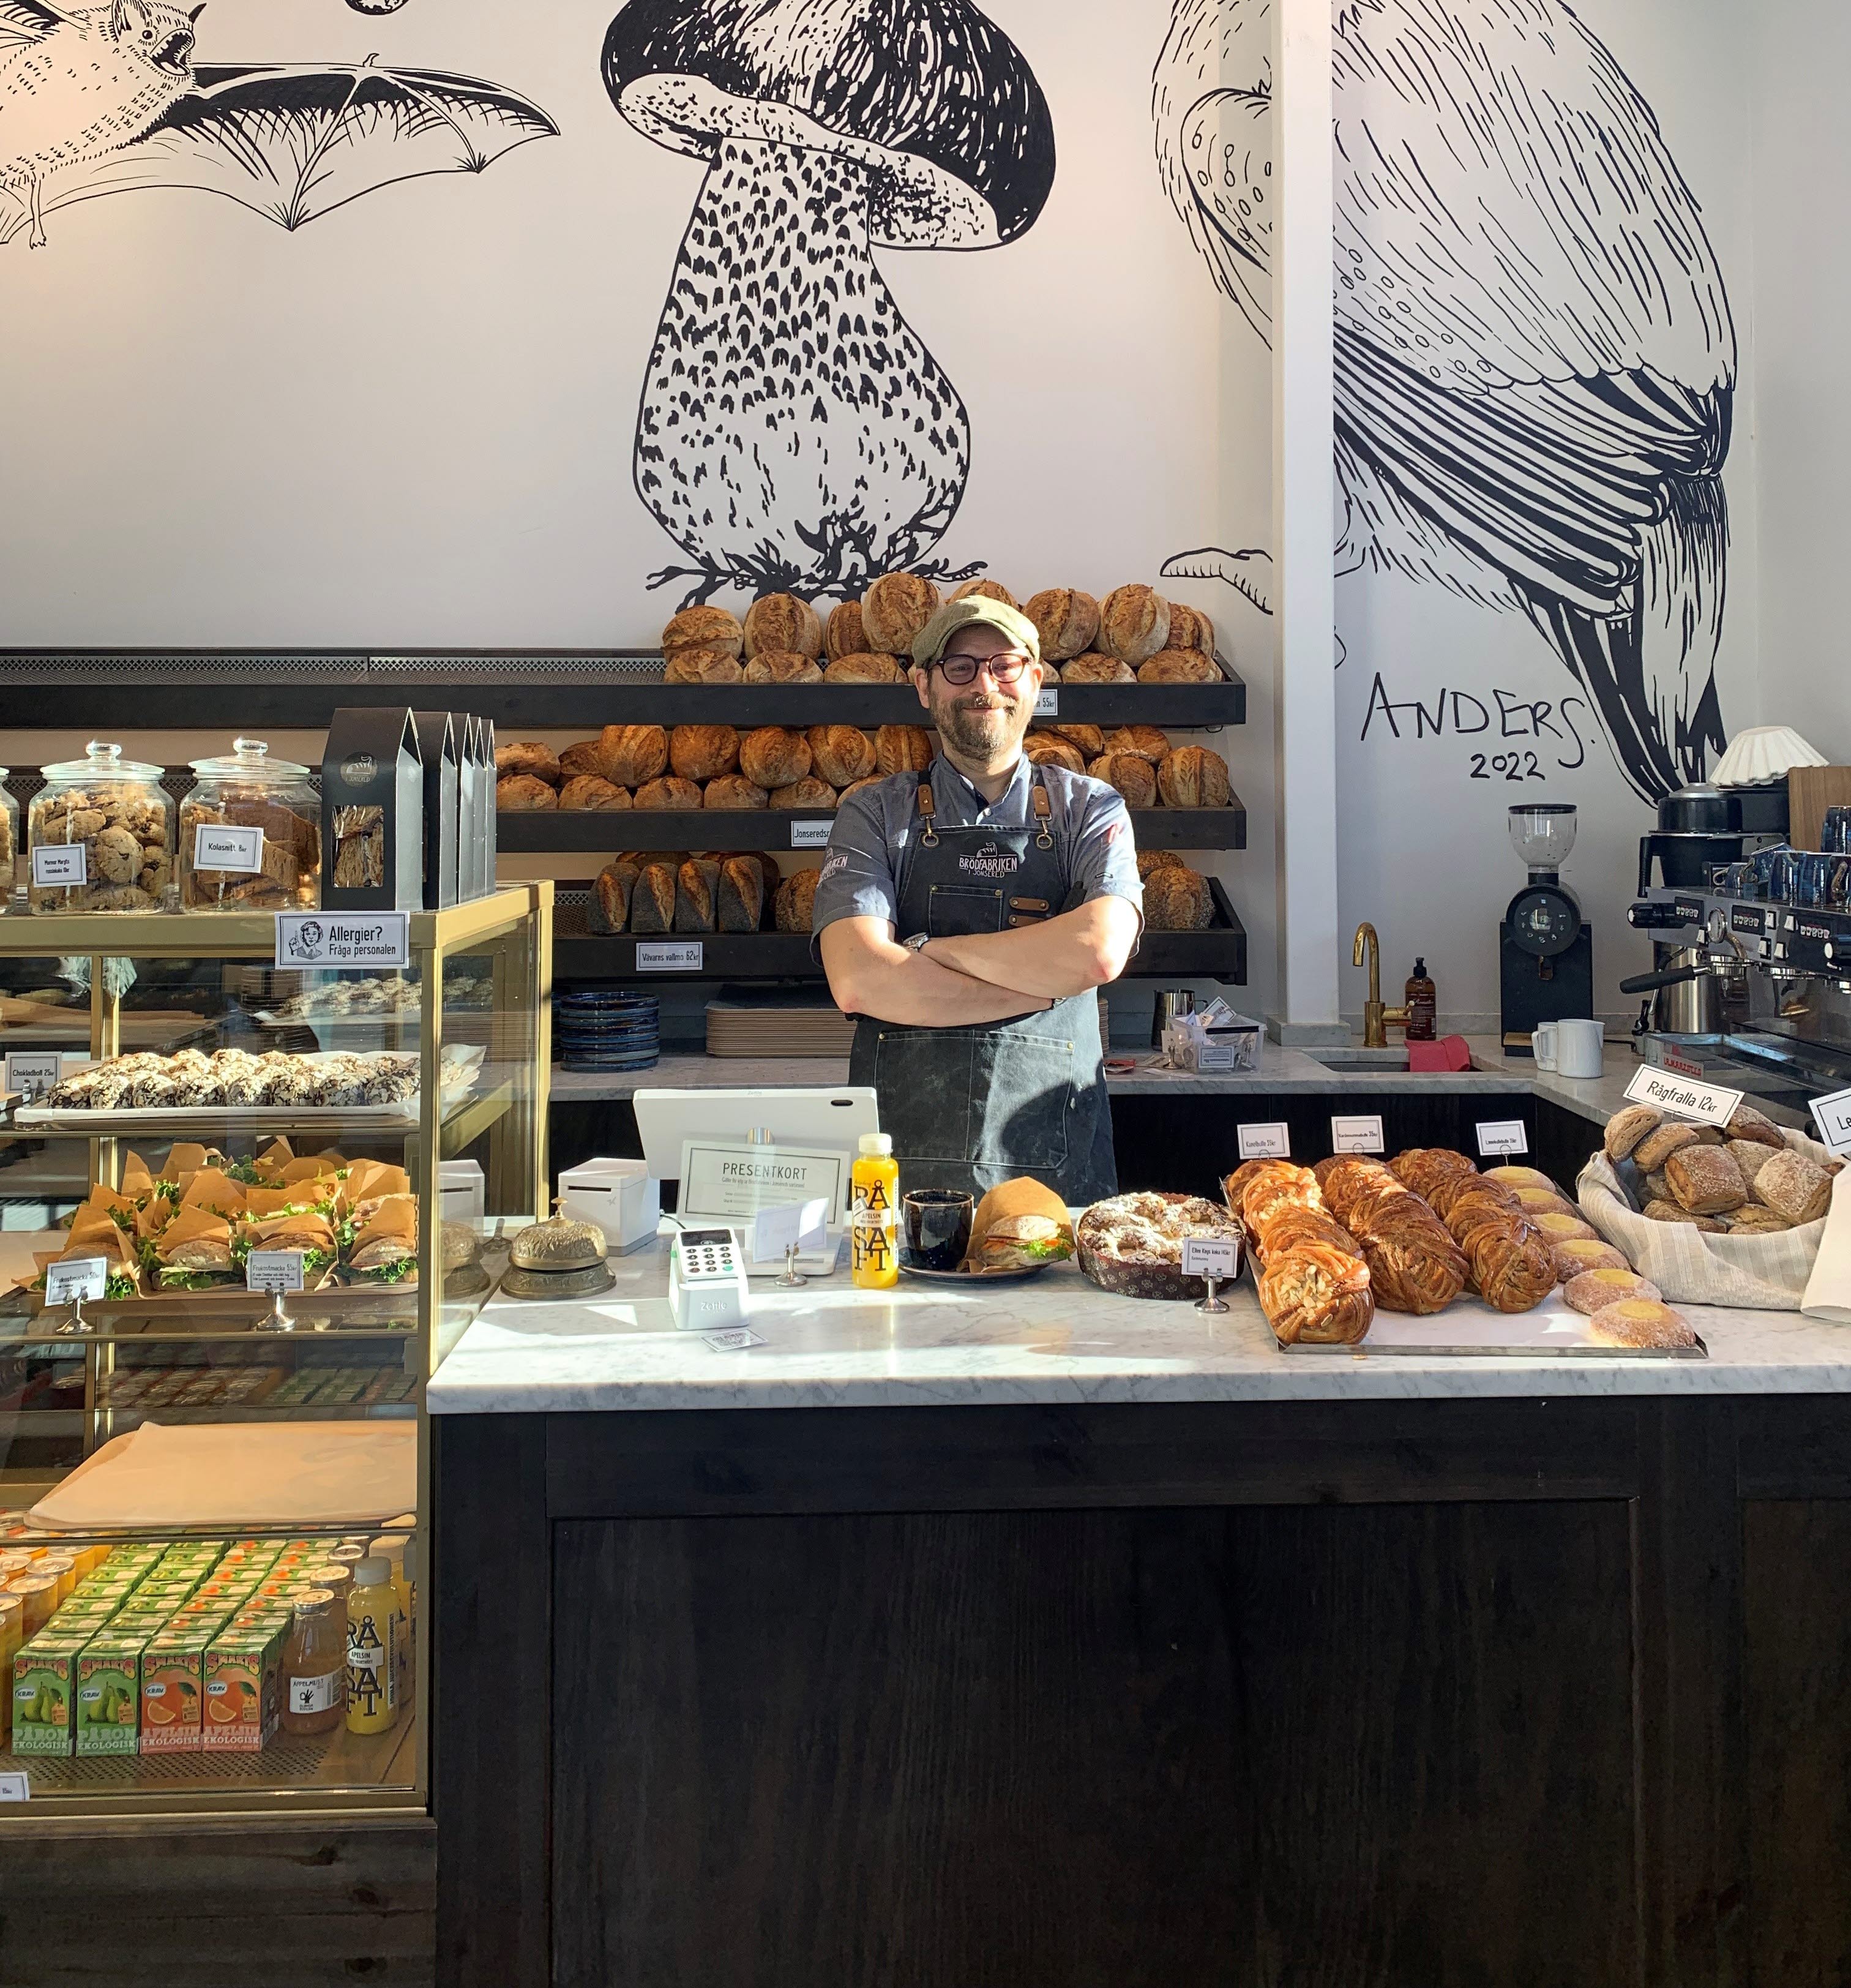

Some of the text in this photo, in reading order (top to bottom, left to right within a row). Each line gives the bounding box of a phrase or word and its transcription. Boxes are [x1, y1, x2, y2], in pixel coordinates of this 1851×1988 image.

[1042, 697, 1054, 708] 55kr
[1470, 751, 1546, 781] 2022
[208, 842, 235, 852] Kolasnitt
[959, 857, 1017, 871] BRÖDFABRIKEN
[329, 926, 383, 945] Allergier?
[329, 943, 396, 958] Fråga personalen
[686, 950, 699, 961] 62kr
[1647, 1081, 1718, 1112] Rågfralla 12kr
[723, 1163, 807, 1180] PRESENTKORT
[53, 1273, 88, 1284] Frukostmacka
[17, 1689, 36, 1698] KRAV
[81, 1690, 100, 1699] KRAV
[143, 1736, 200, 1746] EKOLOGISK
[204, 1735, 260, 1744] EKOLOGISK
[78, 1741, 136, 1750] EKOLOGISK
